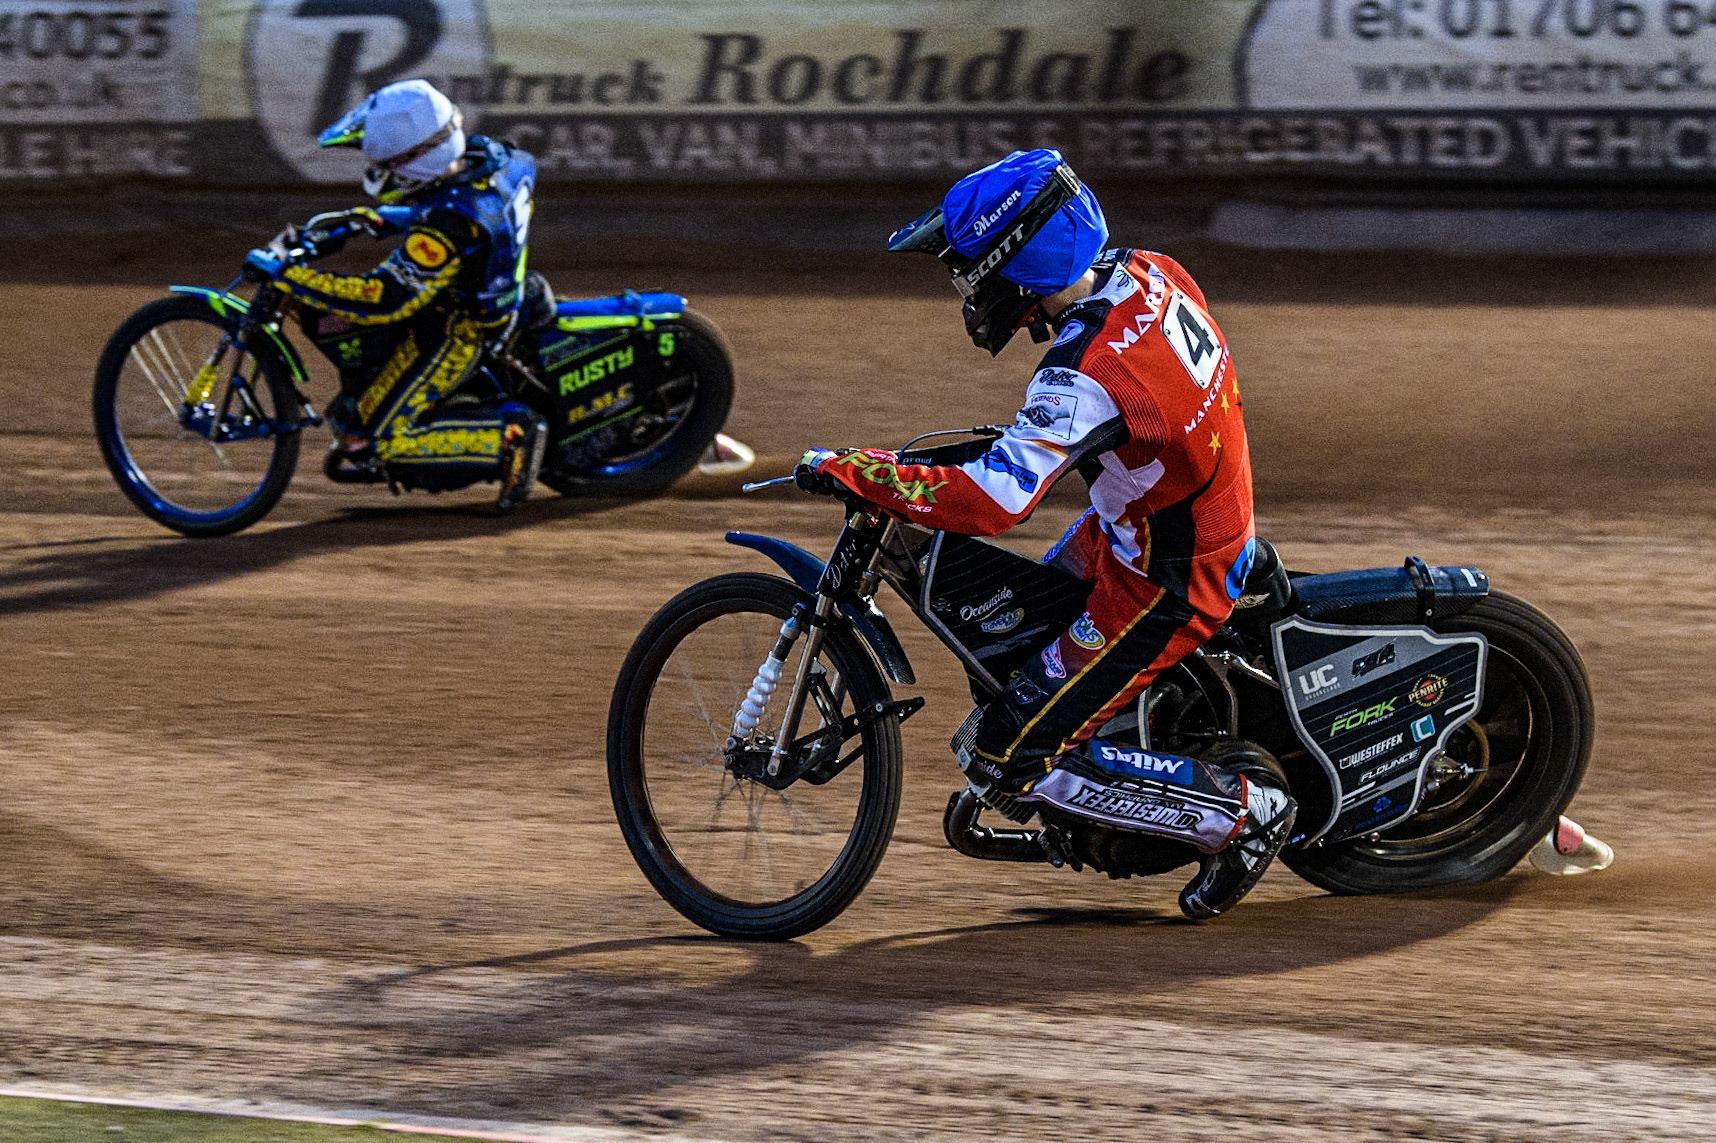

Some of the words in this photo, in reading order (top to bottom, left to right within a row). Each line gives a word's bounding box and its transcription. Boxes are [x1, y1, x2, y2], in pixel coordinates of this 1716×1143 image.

[690, 28, 1197, 106] Rochdale
[1517, 119, 1716, 168] VEHIC
[973, 189, 1022, 237] Marson
[966, 223, 1024, 287] SCOTT
[657, 332, 675, 357] 5
[1176, 302, 1216, 367] 4
[558, 345, 635, 396] RUSTY
[959, 585, 1014, 621] Oceanside
[1299, 663, 1338, 694] UC
[1408, 677, 1448, 703] PENRITE
[1329, 696, 1398, 737] FORK
[1100, 746, 1185, 775] Mitas
[1350, 732, 1404, 765] WESTEFFEX
[1070, 786, 1182, 828] WESTEFFEX
